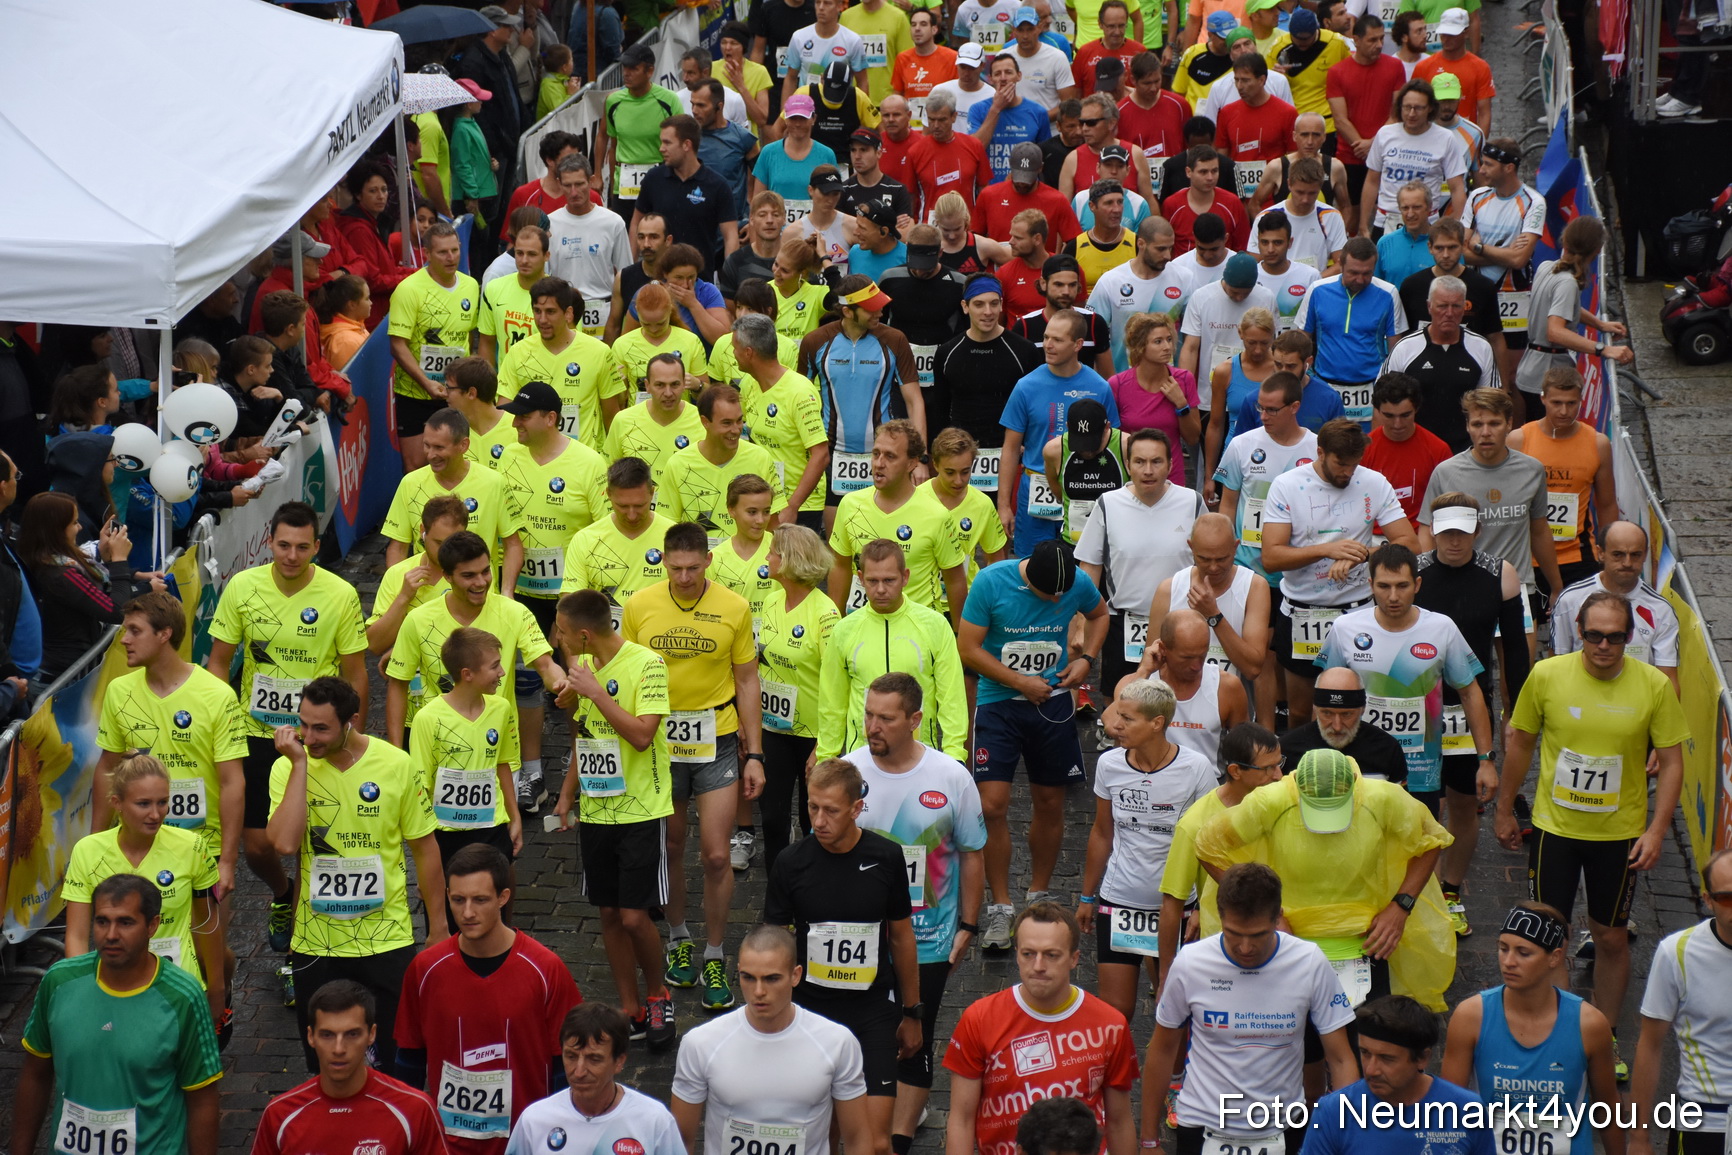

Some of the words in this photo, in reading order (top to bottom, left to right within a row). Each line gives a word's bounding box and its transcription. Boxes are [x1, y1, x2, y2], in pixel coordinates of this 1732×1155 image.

[978, 31, 999, 44] 347
[1196, 69, 1211, 77] Peter
[327, 113, 356, 165] PARTL
[357, 76, 390, 135] Neumarkt
[1398, 153, 1433, 164] STIFTUNG
[1240, 170, 1264, 184] 588
[1386, 166, 1426, 181] 2015
[505, 309, 534, 323] Müller
[564, 377, 580, 385] Partl
[1337, 389, 1370, 407] 610
[764, 418, 777, 427] Partl
[1068, 481, 1116, 490] Röthenbach
[546, 494, 564, 503] Partl
[657, 501, 670, 510] Partl
[1477, 504, 1527, 520] HMEIER
[540, 516, 557, 524] NEXT
[532, 522, 544, 530] 100
[544, 523, 567, 531] YEARS
[958, 532, 972, 540] Partl
[643, 567, 662, 576] Partl
[527, 579, 549, 588] Alfred
[757, 580, 772, 588] Partl
[297, 625, 317, 634] Partl
[1004, 624, 1063, 634] www.hasit.de
[657, 637, 709, 650] FRANCESCO
[787, 637, 802, 647] Partl
[274, 646, 288, 654] THE
[290, 647, 308, 656] NEXT
[1413, 647, 1434, 656] Hervis
[281, 654, 293, 662] 100
[295, 655, 317, 664] YEARS
[392, 658, 405, 667] Partl
[778, 654, 789, 663] NEXT
[1008, 652, 1057, 672] 2490
[781, 661, 798, 671] YEARS
[264, 714, 298, 725] Dominik
[1169, 720, 1206, 729] KLEBL
[1368, 709, 1420, 732] 2592
[171, 729, 191, 739] Partl
[666, 720, 702, 742] 231
[672, 745, 697, 756] Oliver
[157, 753, 170, 761] THE
[580, 753, 617, 774] 2826
[587, 779, 608, 789] Pascal
[1570, 767, 1608, 791] 171
[440, 782, 492, 807] 2866
[923, 794, 945, 805] Hervis
[1569, 792, 1604, 805] Thomas
[167, 793, 199, 816] 88
[357, 804, 380, 814] Partl
[452, 811, 478, 821] Jonas
[336, 832, 352, 840] THE
[353, 832, 371, 841] NEXT
[343, 840, 356, 849] 100
[357, 840, 381, 850] YEARS
[341, 859, 376, 870] BOCK
[318, 872, 378, 897] 2872
[324, 903, 370, 913] Johannes
[911, 914, 929, 926] 17.
[1118, 909, 1159, 933] 306
[841, 925, 874, 934] BOCK
[1124, 934, 1146, 945] Petra
[822, 939, 867, 964] 164
[827, 969, 857, 981] Albert
[1210, 978, 1234, 986] Wolfgang
[1234, 1011, 1297, 1020] Raiffeisenbank
[1250, 1021, 1284, 1030] Rothsee
[1286, 1021, 1297, 1029] eG
[1013, 1035, 1048, 1050] raumbox
[1056, 1024, 1124, 1055] raum
[475, 1048, 496, 1060] DEHN
[1061, 1051, 1103, 1067] schenken
[466, 1073, 505, 1082] BOCK
[1493, 1075, 1566, 1095] ERDINGER
[442, 1081, 505, 1114] 2624
[981, 1078, 1084, 1118] aumbox
[88, 1112, 128, 1124] BOCK
[453, 1115, 488, 1130] Florian
[760, 1125, 798, 1137] BOCK
[63, 1120, 128, 1155] 3016
[1502, 1128, 1553, 1155] 606
[617, 1142, 642, 1155] Hervis
